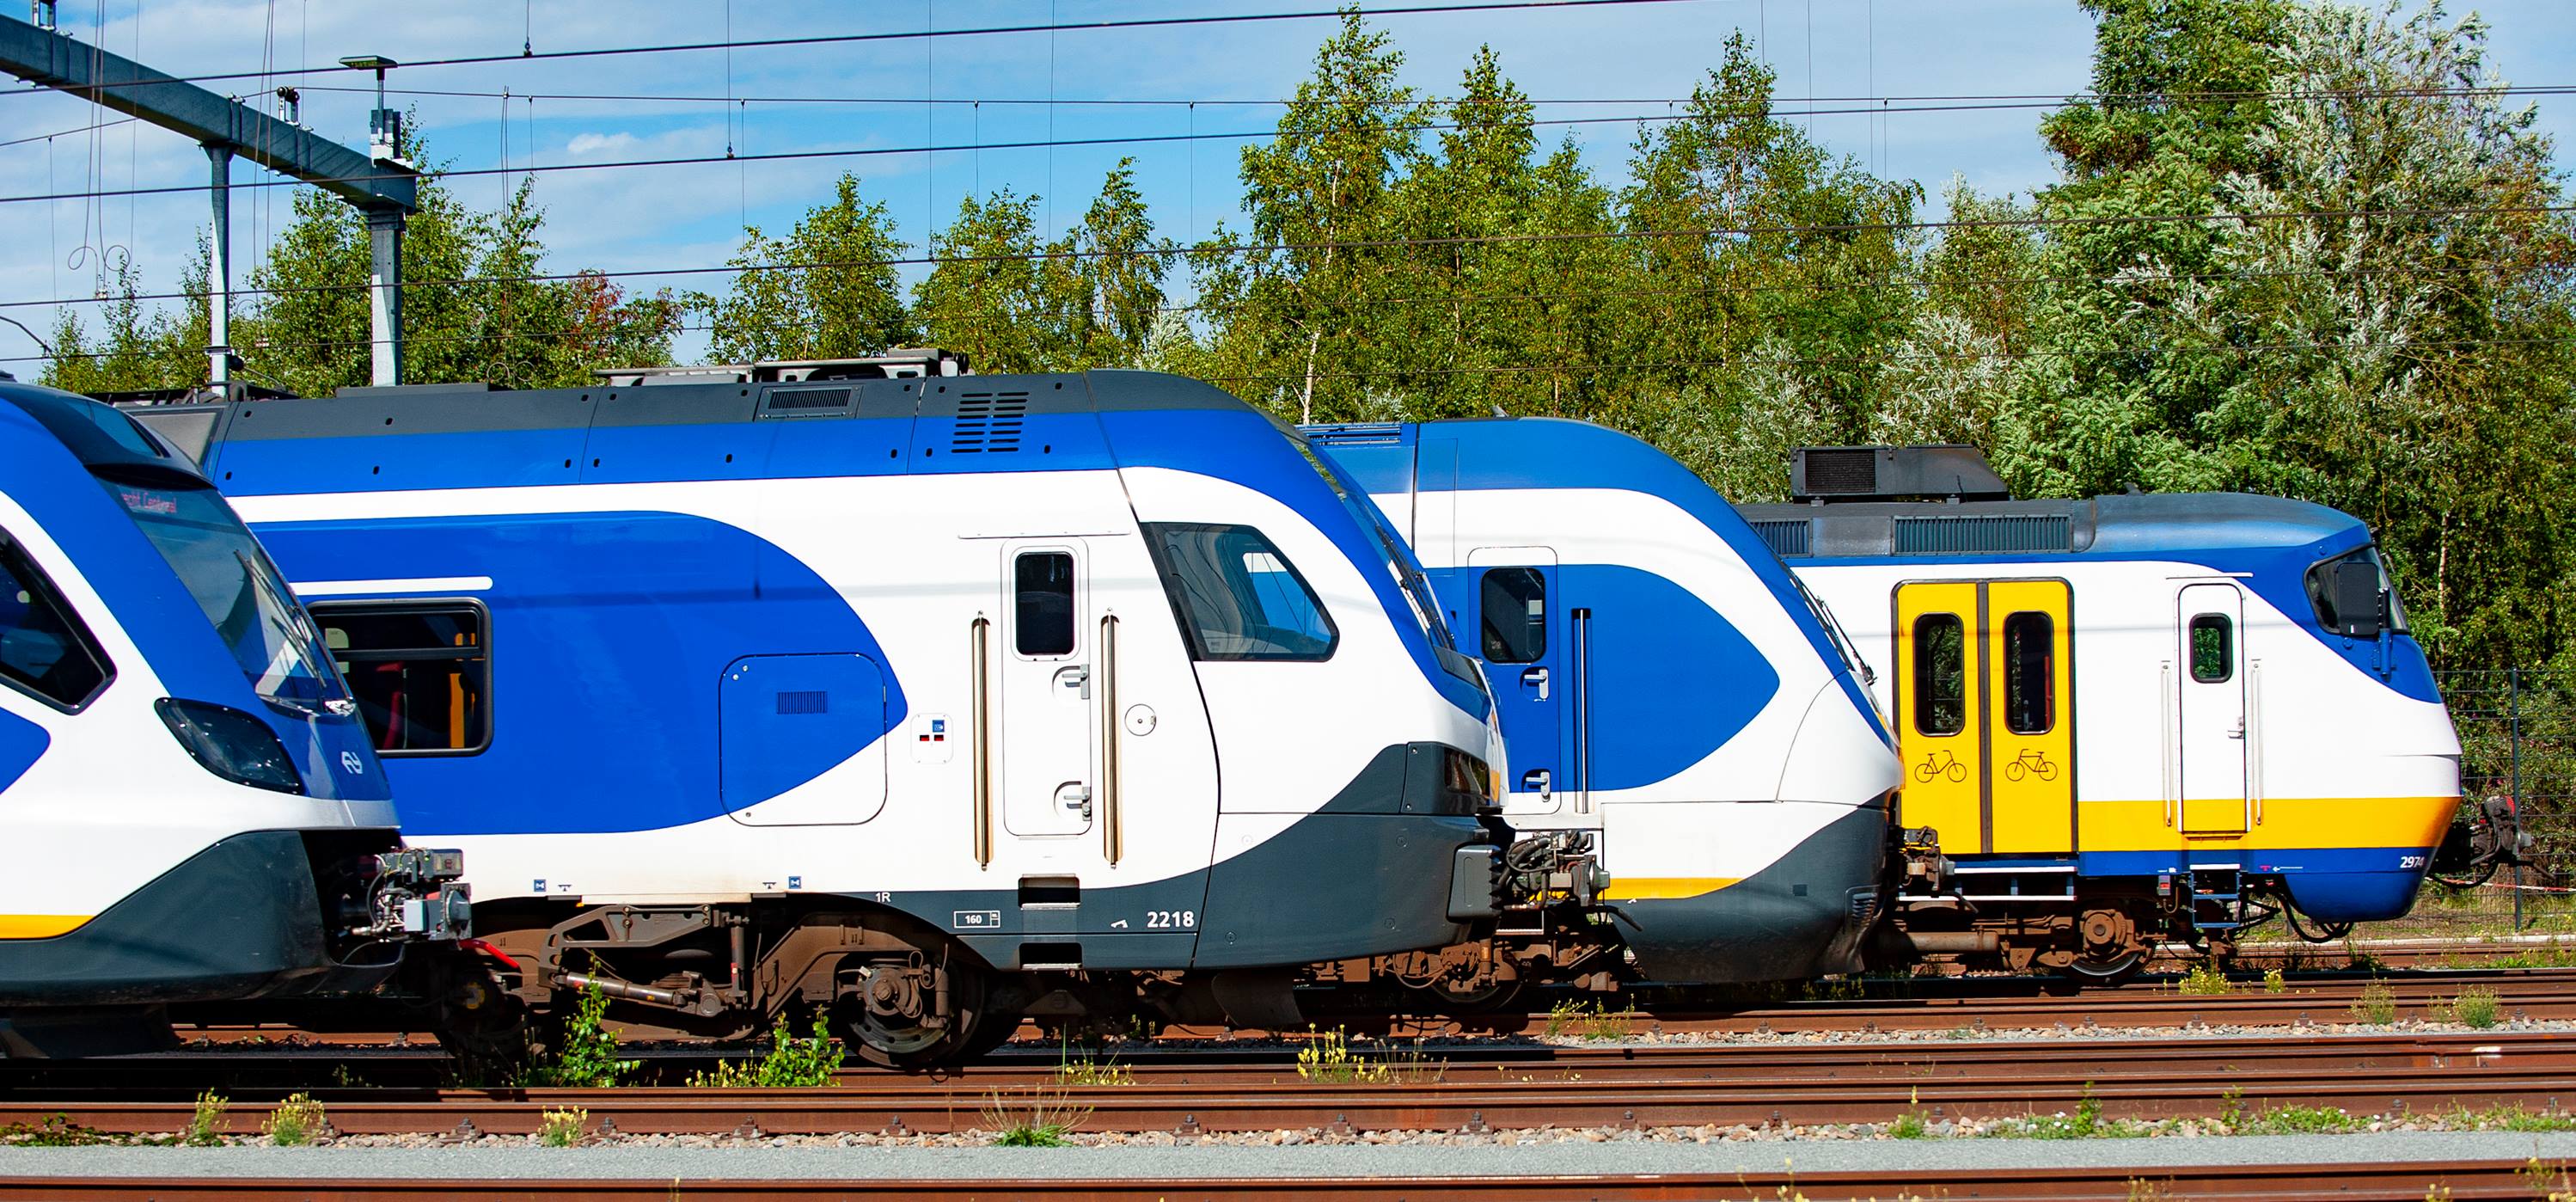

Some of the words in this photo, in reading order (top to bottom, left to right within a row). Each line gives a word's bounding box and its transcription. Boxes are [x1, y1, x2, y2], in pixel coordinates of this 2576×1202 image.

[2399, 856, 2426, 868] 2974
[875, 892, 891, 903] 1R
[964, 914, 982, 924] 160
[1147, 911, 1195, 928] 2218
